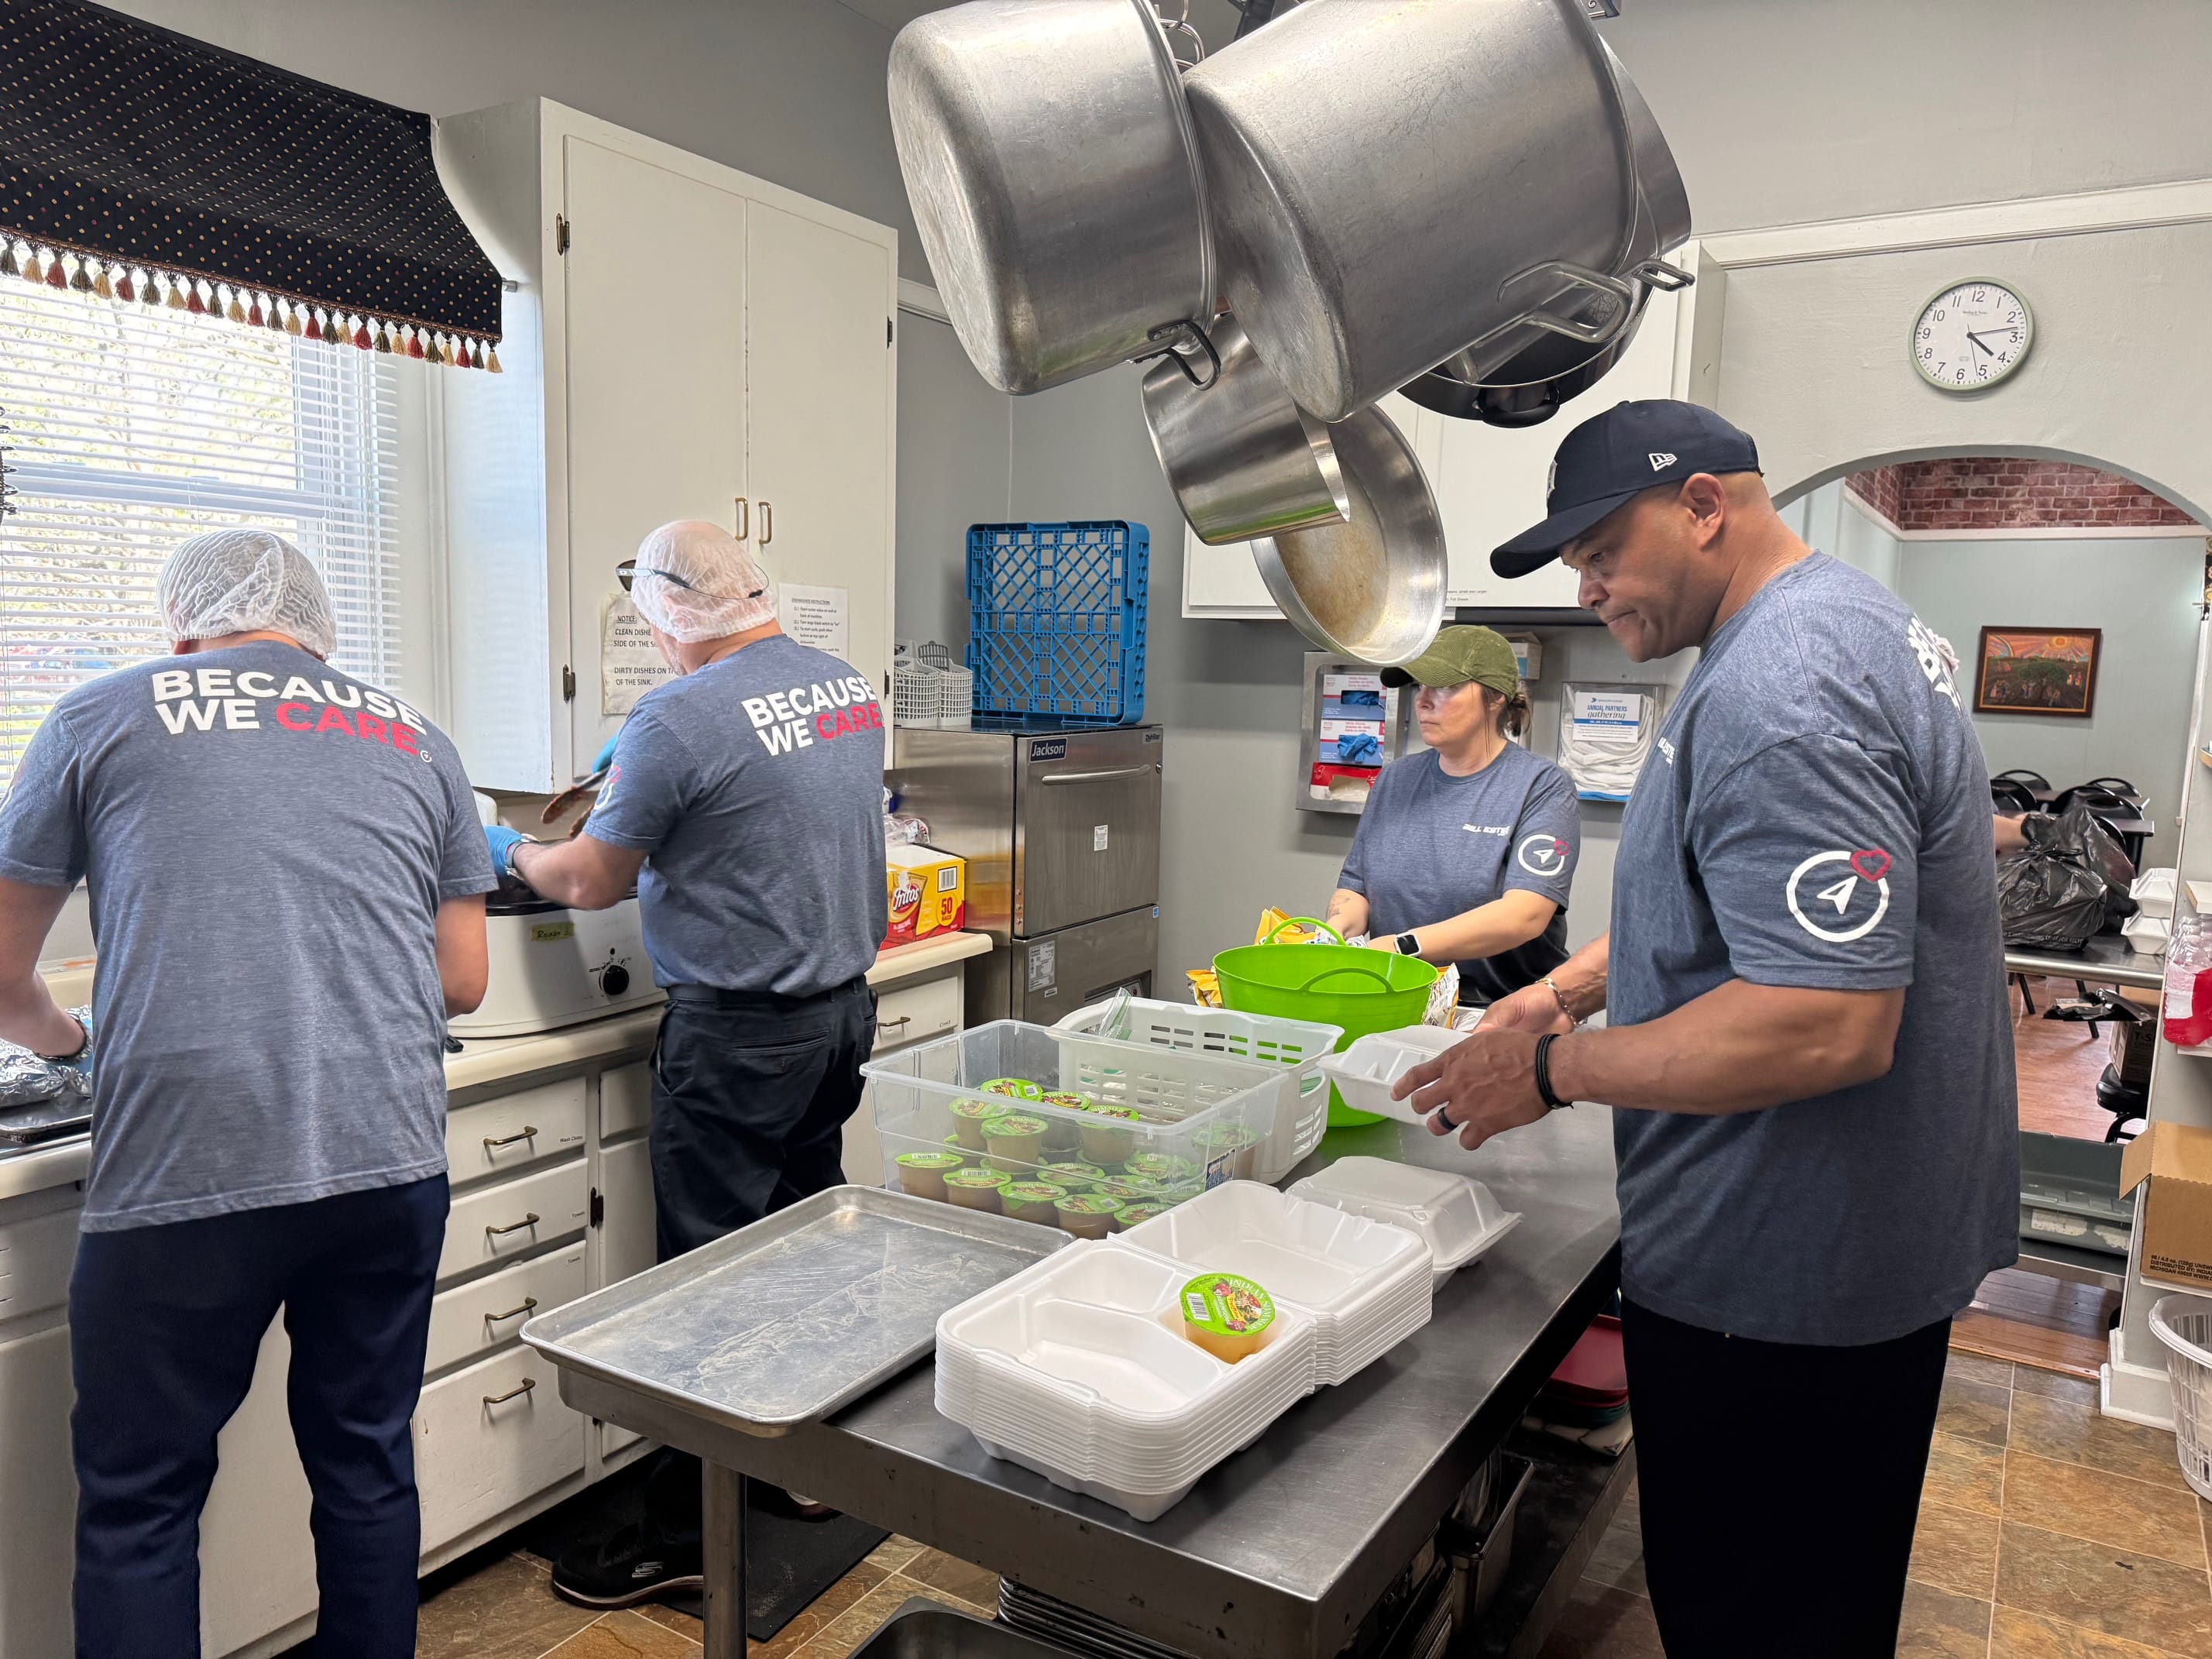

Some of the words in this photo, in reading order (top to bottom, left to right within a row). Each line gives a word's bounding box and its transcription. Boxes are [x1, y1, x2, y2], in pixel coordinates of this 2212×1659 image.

[1953, 295, 1961, 308] 11
[1971, 290, 1985, 303] 12
[1996, 296, 2001, 308] 1
[1932, 310, 1945, 322] 10
[2006, 311, 2016, 323] 2
[1922, 328, 1931, 339] 9
[2009, 331, 2019, 343] 3
[1924, 348, 1933, 359] 8
[1997, 351, 2007, 363] 4
[1938, 362, 1946, 373] 7
[1978, 365, 1988, 376] 5
[1956, 368, 1966, 380] 6
[152, 668, 427, 736] BECAUSE
[740, 676, 878, 728] BECAUSE
[1588, 710, 1625, 719] gathering
[155, 699, 260, 735] WE
[275, 702, 418, 756] CARE
[756, 718, 813, 756] WE
[816, 702, 883, 740] CARE
[1032, 742, 1064, 757] Jackson
[941, 897, 953, 914] 50
[2150, 1265, 2176, 1274] MICHIGAN
[2151, 1259, 2185, 1270] DISTRIBUTED
[1229, 1279, 1264, 1300] INDIAN
